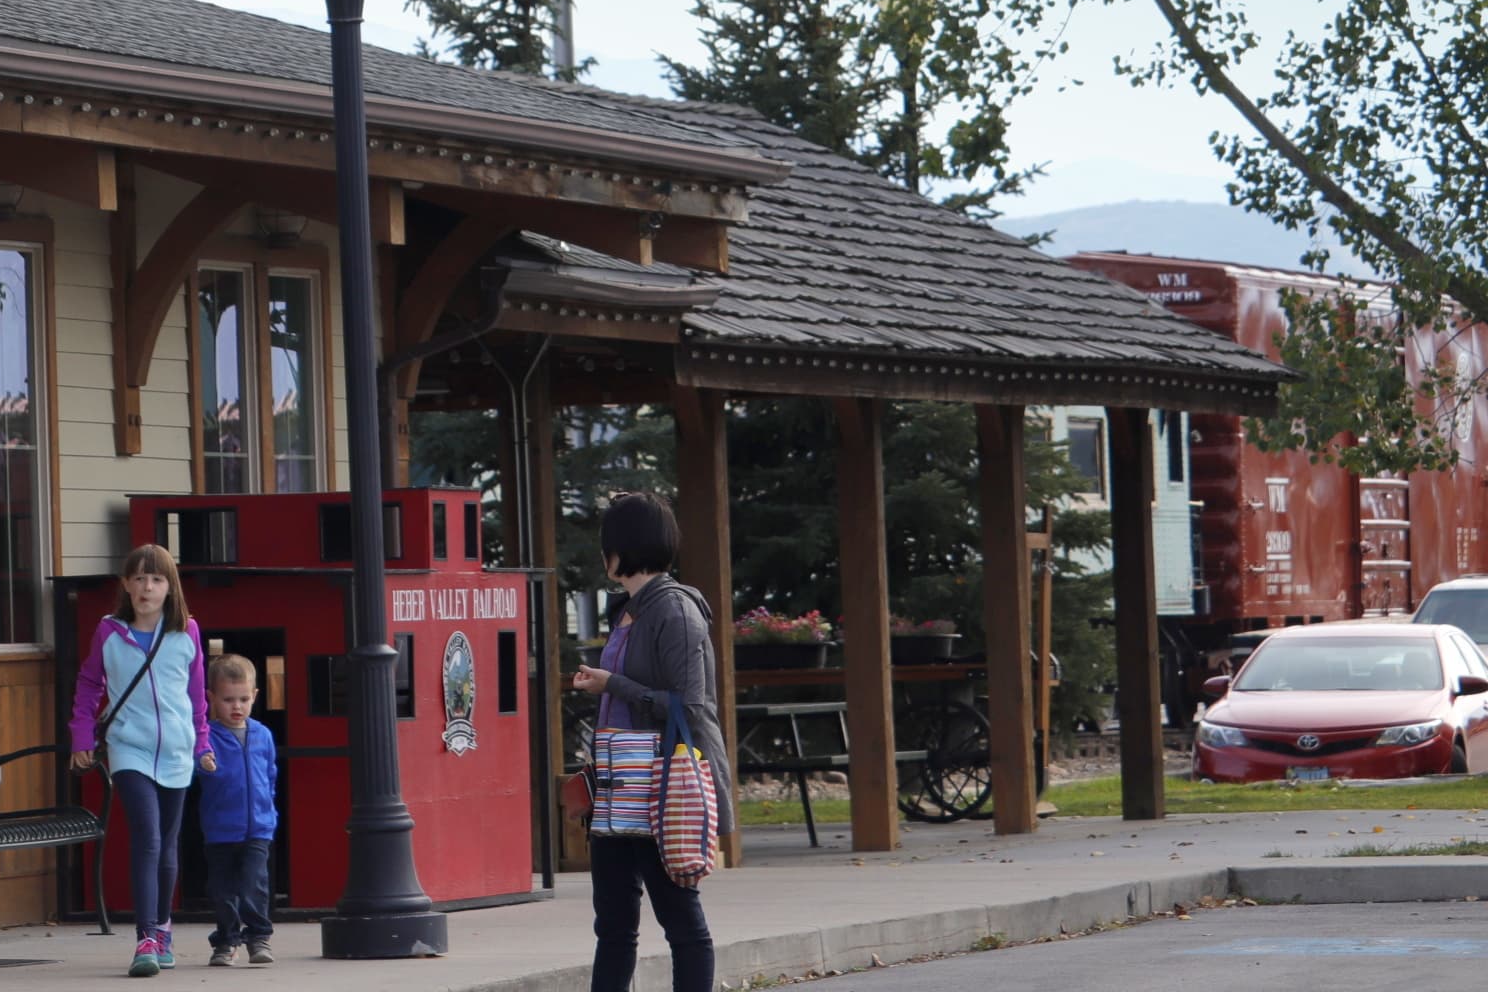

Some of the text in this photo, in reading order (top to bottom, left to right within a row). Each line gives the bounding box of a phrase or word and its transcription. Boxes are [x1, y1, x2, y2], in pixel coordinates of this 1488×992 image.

[1157, 272, 1188, 287] WM
[392, 587, 518, 622] HEBER VALLEY RAILROAD
